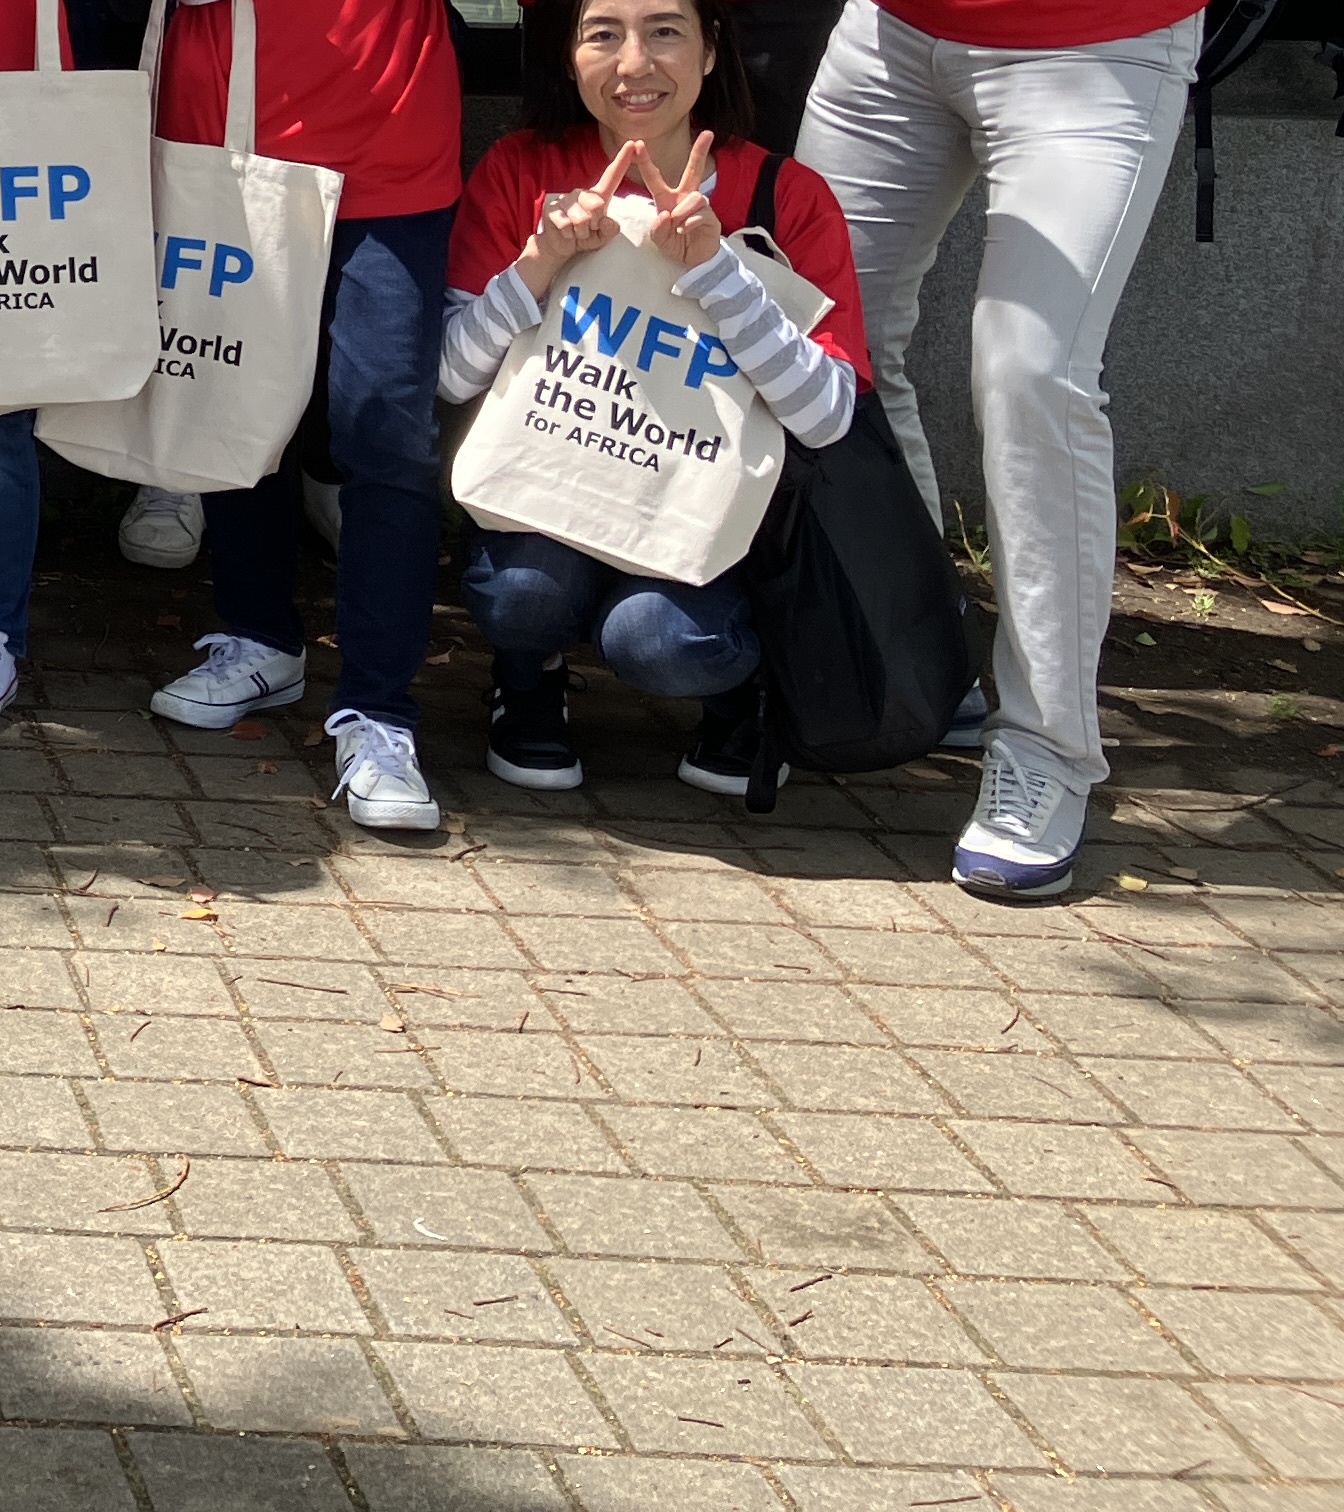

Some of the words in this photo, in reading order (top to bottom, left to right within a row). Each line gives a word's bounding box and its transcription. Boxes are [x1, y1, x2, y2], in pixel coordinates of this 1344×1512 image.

[154, 231, 254, 298] FP
[561, 285, 739, 389] WFP
[545, 345, 638, 401] Walk
[524, 410, 561, 435] for
[565, 426, 661, 472] AFRICA
[534, 377, 596, 421] the
[611, 402, 722, 464] World
